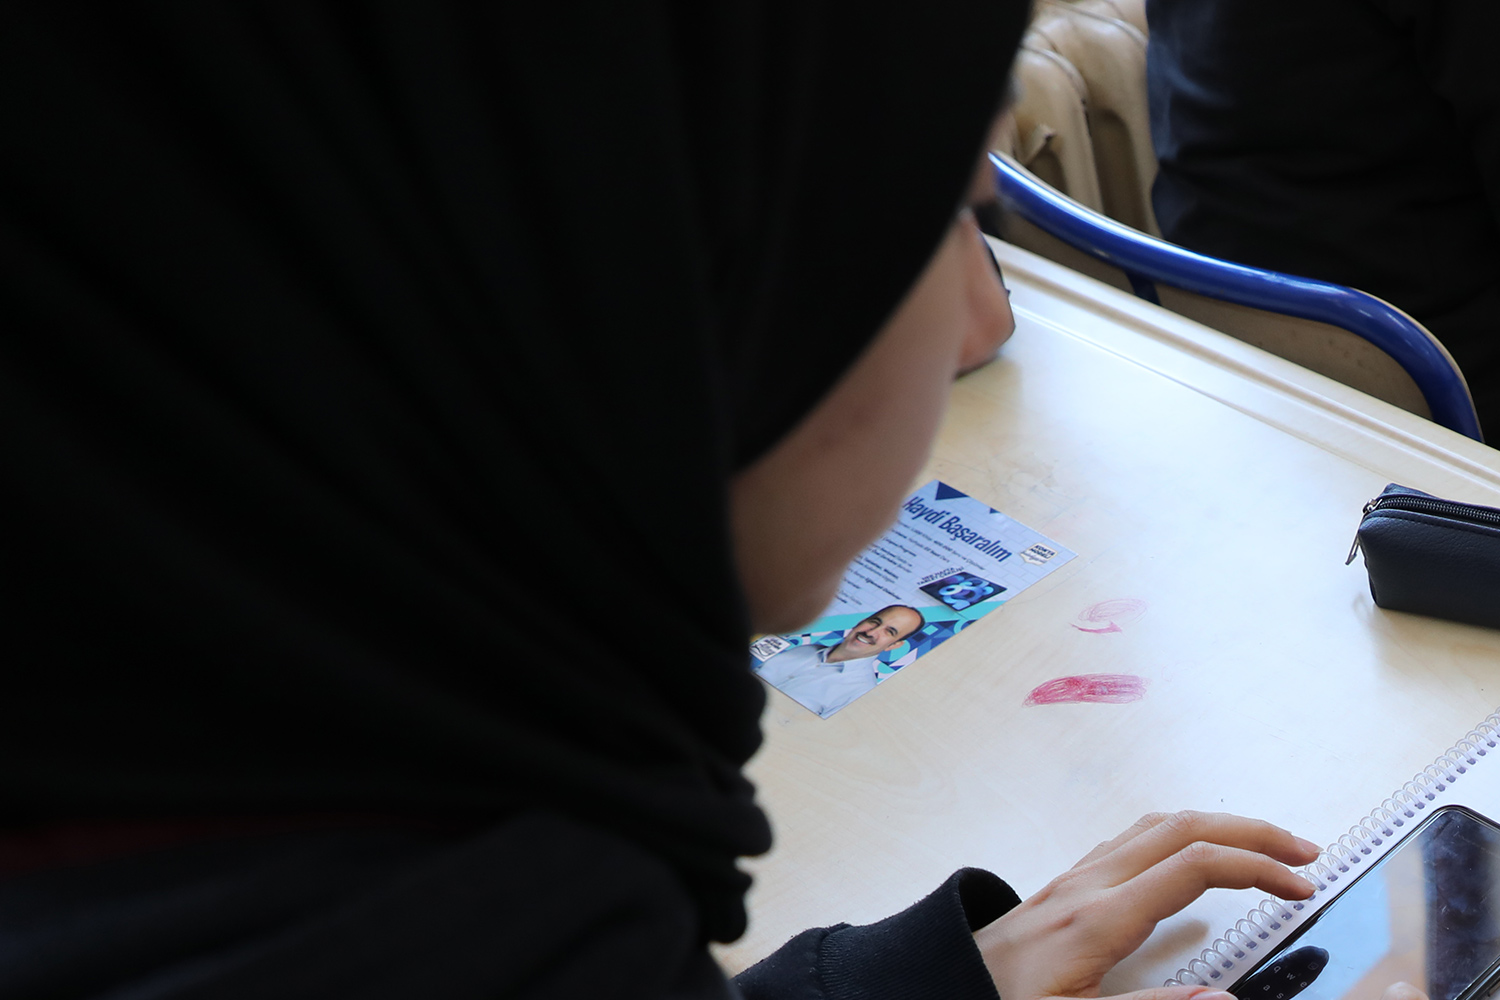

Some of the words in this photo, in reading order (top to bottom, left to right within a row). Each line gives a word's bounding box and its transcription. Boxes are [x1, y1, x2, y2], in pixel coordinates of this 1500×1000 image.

[902, 496, 949, 524] Haydi
[937, 515, 1012, 562] Başaralım
[1273, 965, 1281, 974] q
[1286, 972, 1296, 980] w
